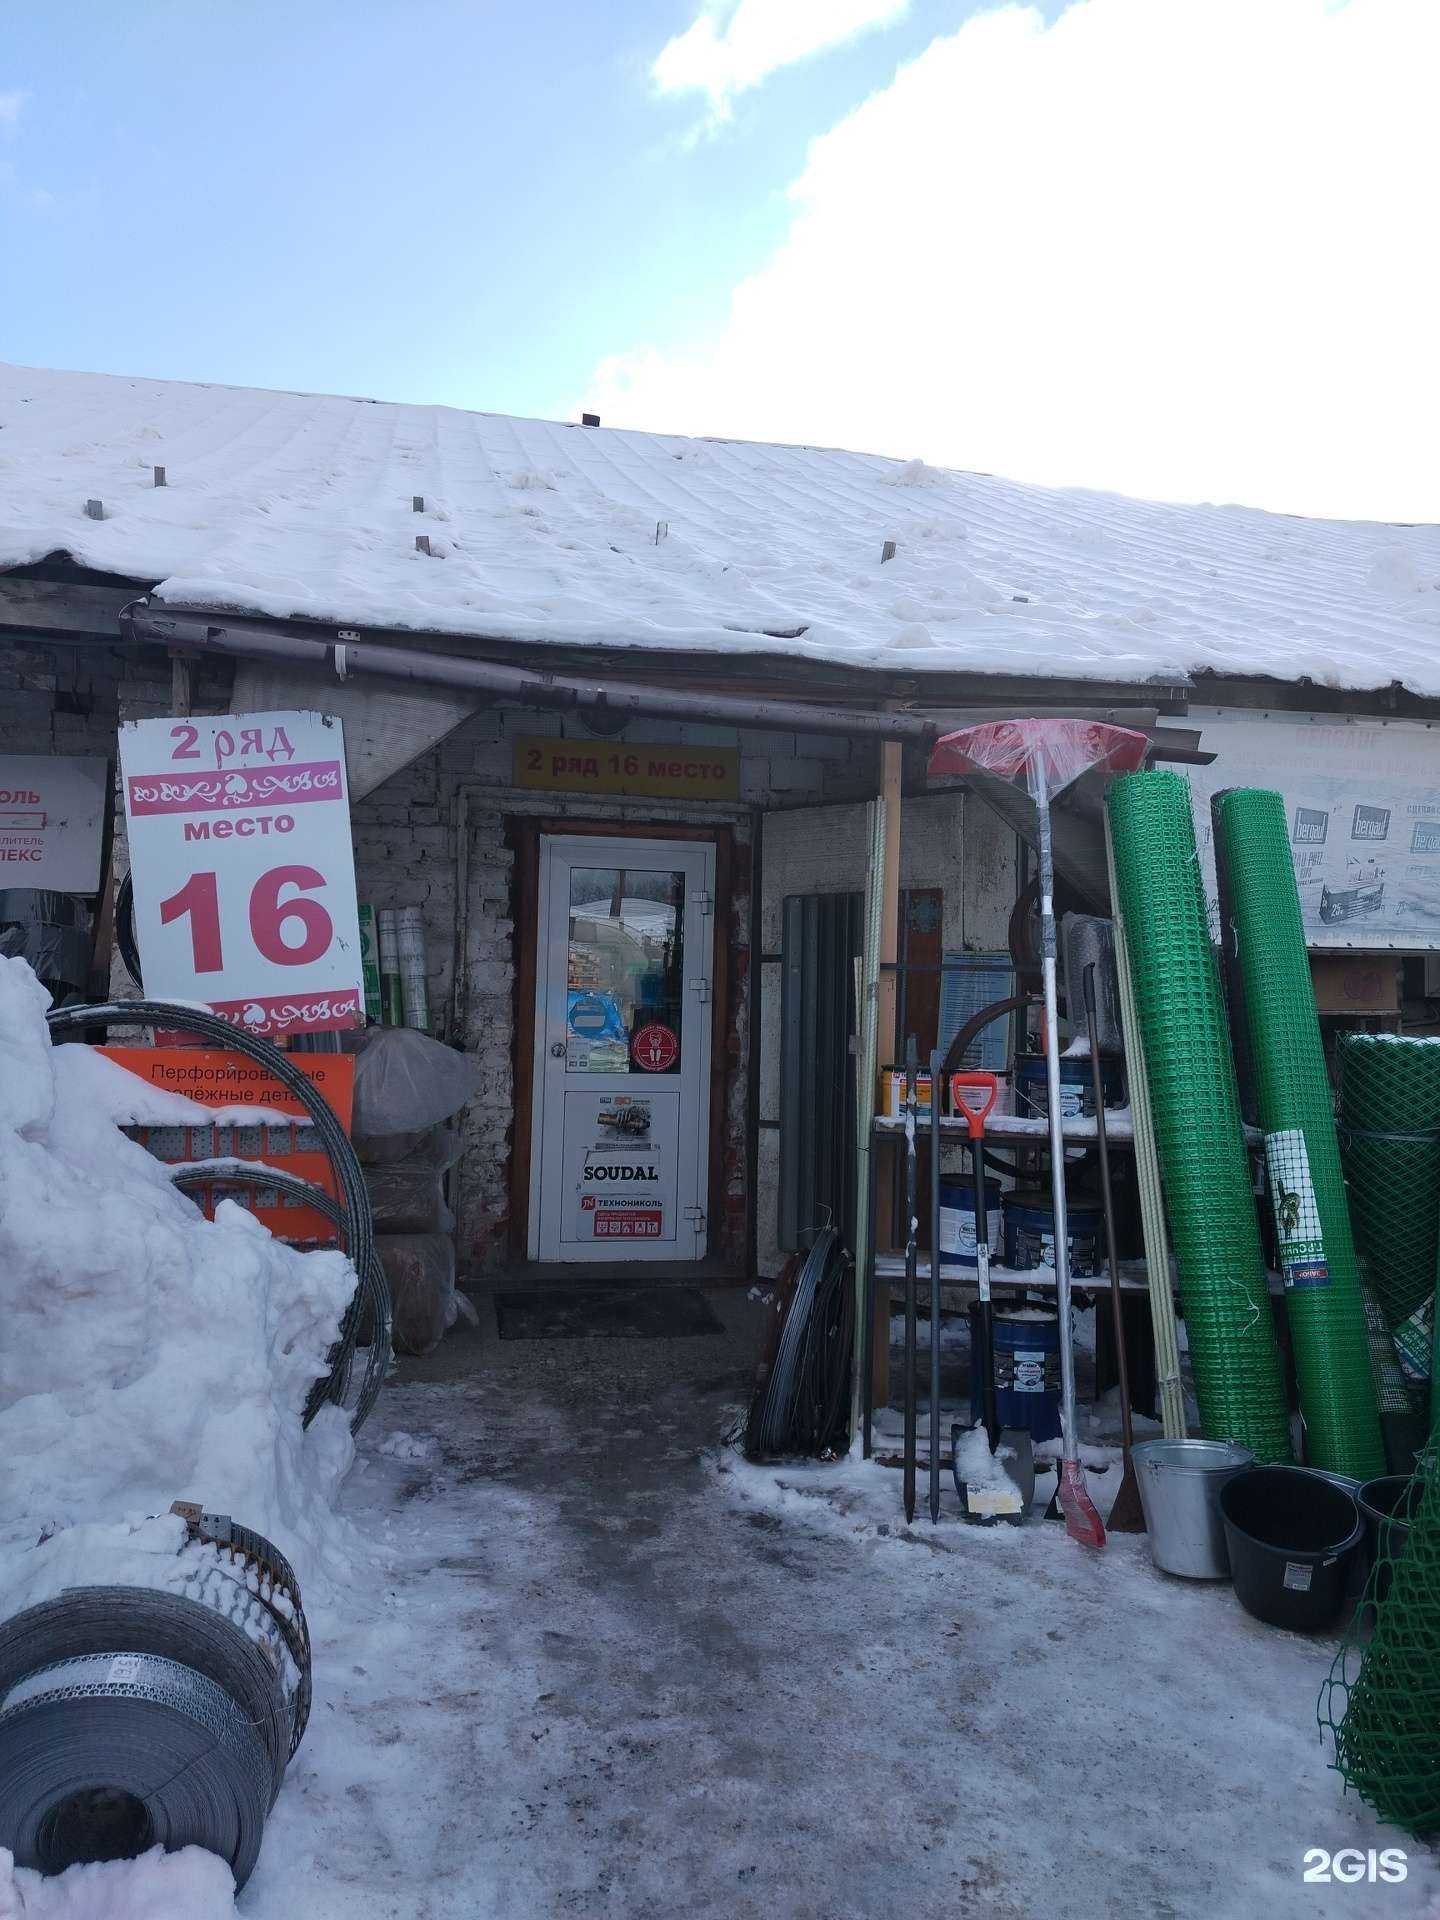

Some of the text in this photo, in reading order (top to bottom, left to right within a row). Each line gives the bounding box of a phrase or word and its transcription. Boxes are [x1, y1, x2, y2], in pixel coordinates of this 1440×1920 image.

[170, 725, 295, 769] 2 ряд
[527, 749, 726, 779] 2 ряд 16 место
[183, 812, 296, 842] место
[160, 864, 333, 975] 16
[151, 1064, 326, 1084] Перфорироваые
[583, 1166, 659, 1181] SOUDAL
[598, 1199, 663, 1207] ТЕХНОНИКОЛЬ
